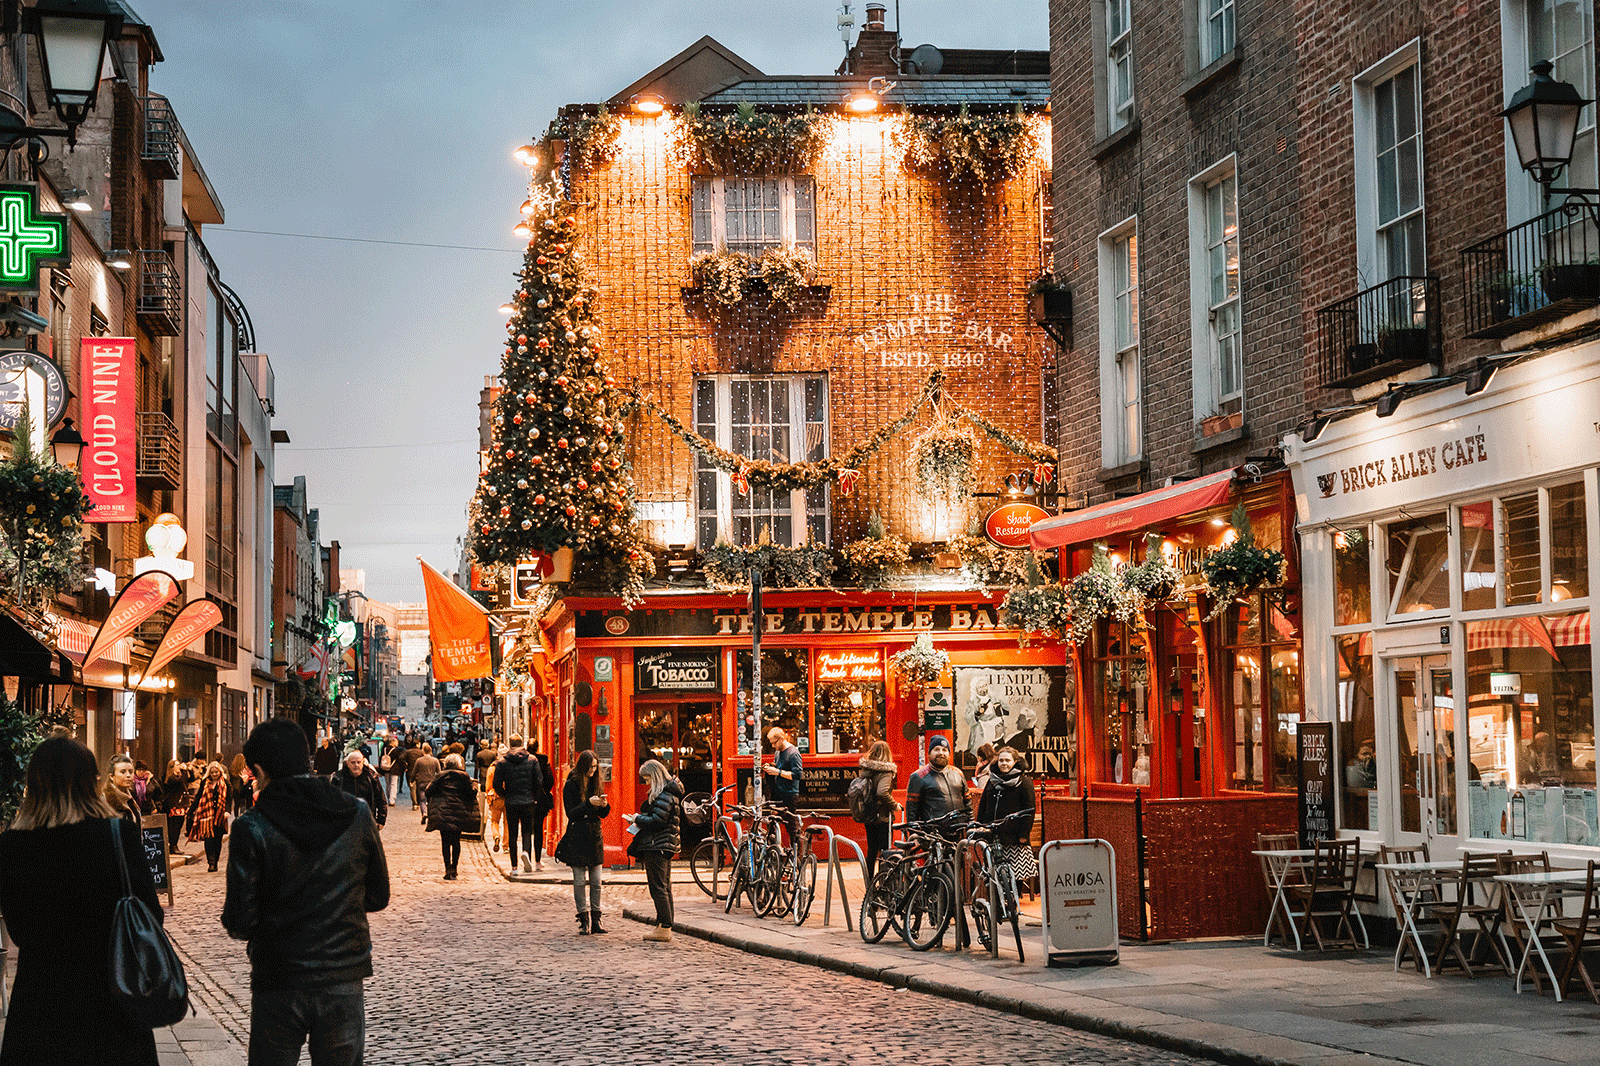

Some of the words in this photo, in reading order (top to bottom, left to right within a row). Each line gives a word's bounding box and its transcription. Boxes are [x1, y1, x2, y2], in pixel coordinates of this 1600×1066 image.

[909, 294, 957, 312] THE
[854, 316, 953, 352] TEMPLE
[965, 320, 1012, 352] BAR
[942, 352, 984, 367] 1840
[92, 345, 124, 405] NINE
[92, 414, 124, 496] CLOUD
[1340, 459, 1388, 494] BRICK
[1391, 446, 1437, 483] ALLEY
[1441, 425, 1488, 470] CAFÉ
[110, 600, 145, 630] CLOUD
[714, 613, 785, 634] THE
[799, 611, 934, 633] TEMPLE
[609, 620, 624, 631] 48
[166, 623, 195, 649] CLOUD
[452, 639, 472, 647] THE
[438, 644, 487, 658] TEMPLE
[820, 651, 880, 667] Traditional
[451, 655, 477, 666] BAR
[647, 665, 709, 687] TOBACCO
[819, 665, 847, 678] Irish
[851, 665, 882, 679] Music
[986, 673, 1048, 685] TEMPLE
[1004, 685, 1034, 697] BAR
[1302, 734, 1326, 748] BRICK
[1303, 748, 1327, 761] ALLEY
[1054, 871, 1105, 888] ARIOSA
